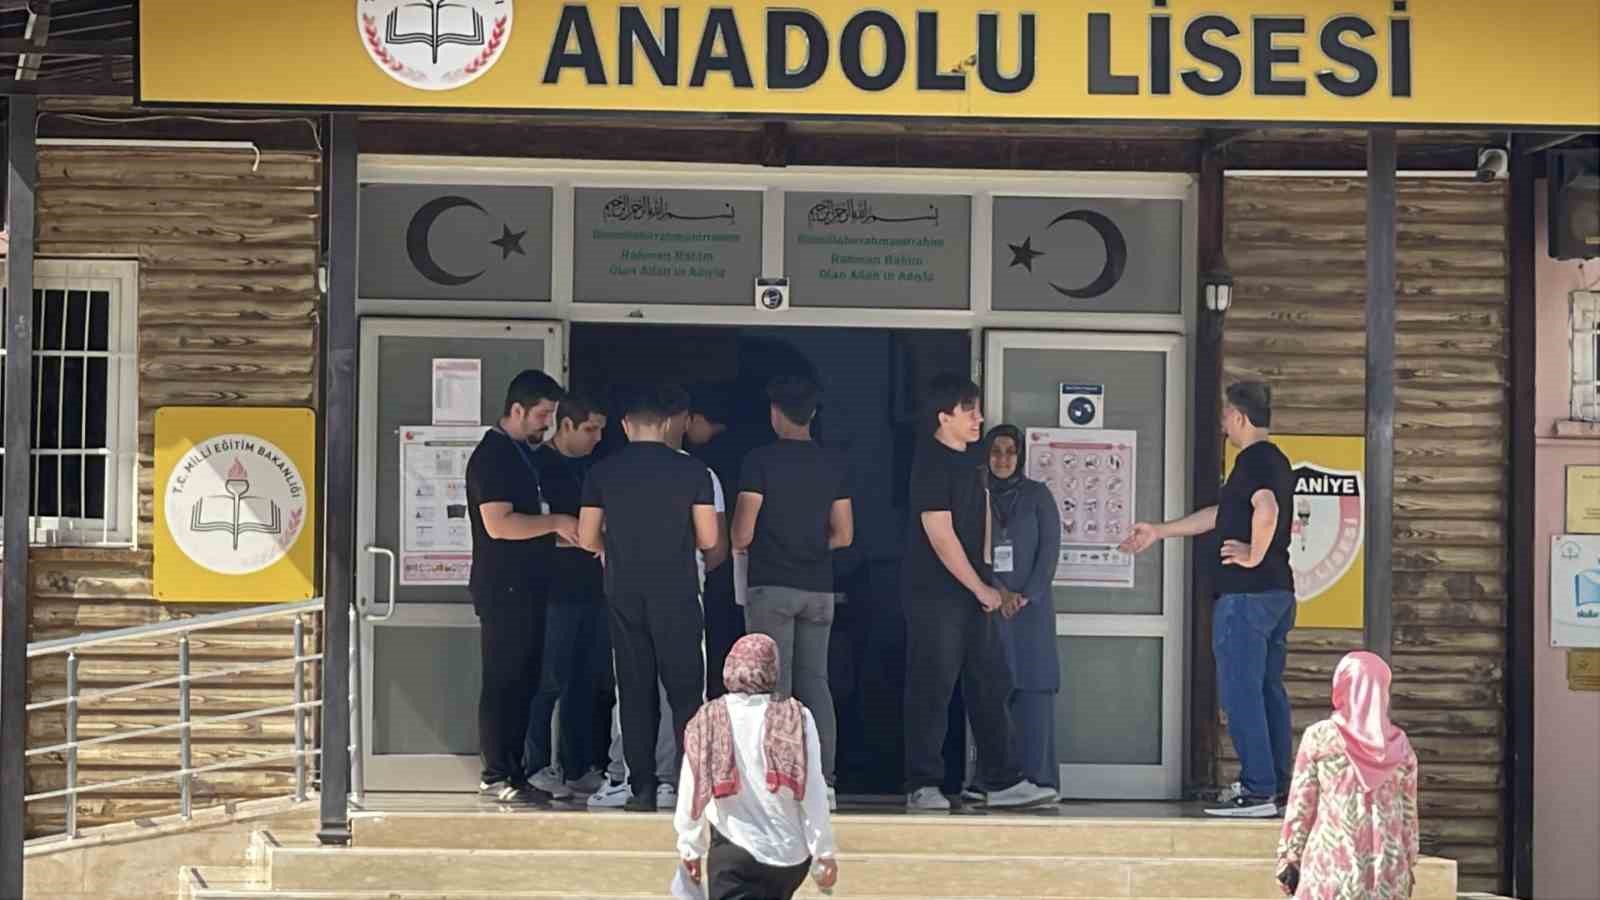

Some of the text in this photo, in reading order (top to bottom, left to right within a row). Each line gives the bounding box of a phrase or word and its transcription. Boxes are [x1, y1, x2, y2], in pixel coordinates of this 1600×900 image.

[542, 0, 1412, 98] ANADOLU LİSESİ
[172, 439, 301, 498] T.C. MİLLİ EĞİTİM BAKANLIĞI
[1295, 475, 1355, 494] ANİYE
